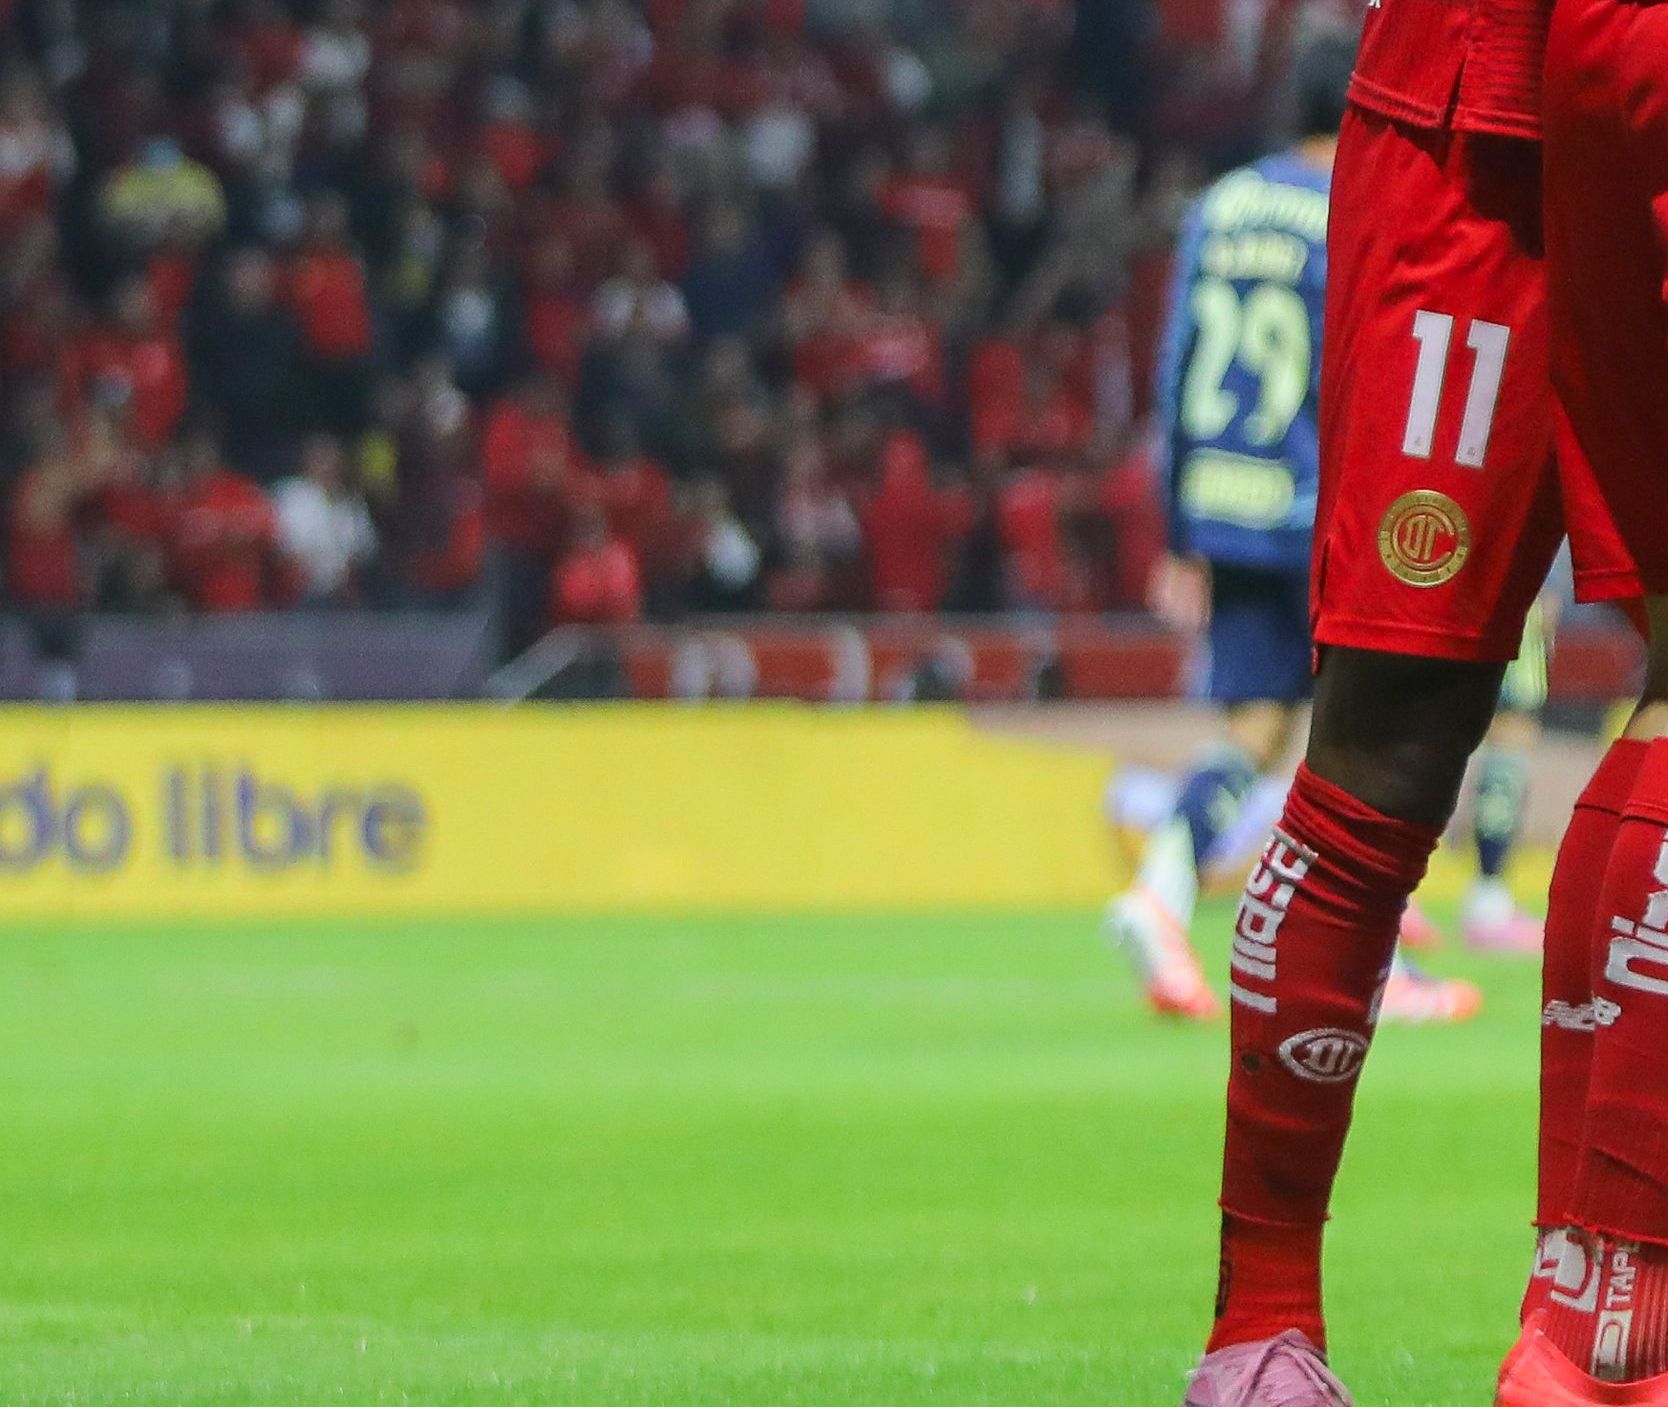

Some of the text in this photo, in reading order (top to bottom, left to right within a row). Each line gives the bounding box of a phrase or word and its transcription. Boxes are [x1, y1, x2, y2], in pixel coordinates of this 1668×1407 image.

[1182, 276, 1312, 444] 29
[1402, 309, 1510, 467] 11
[160, 757, 430, 877] libre
